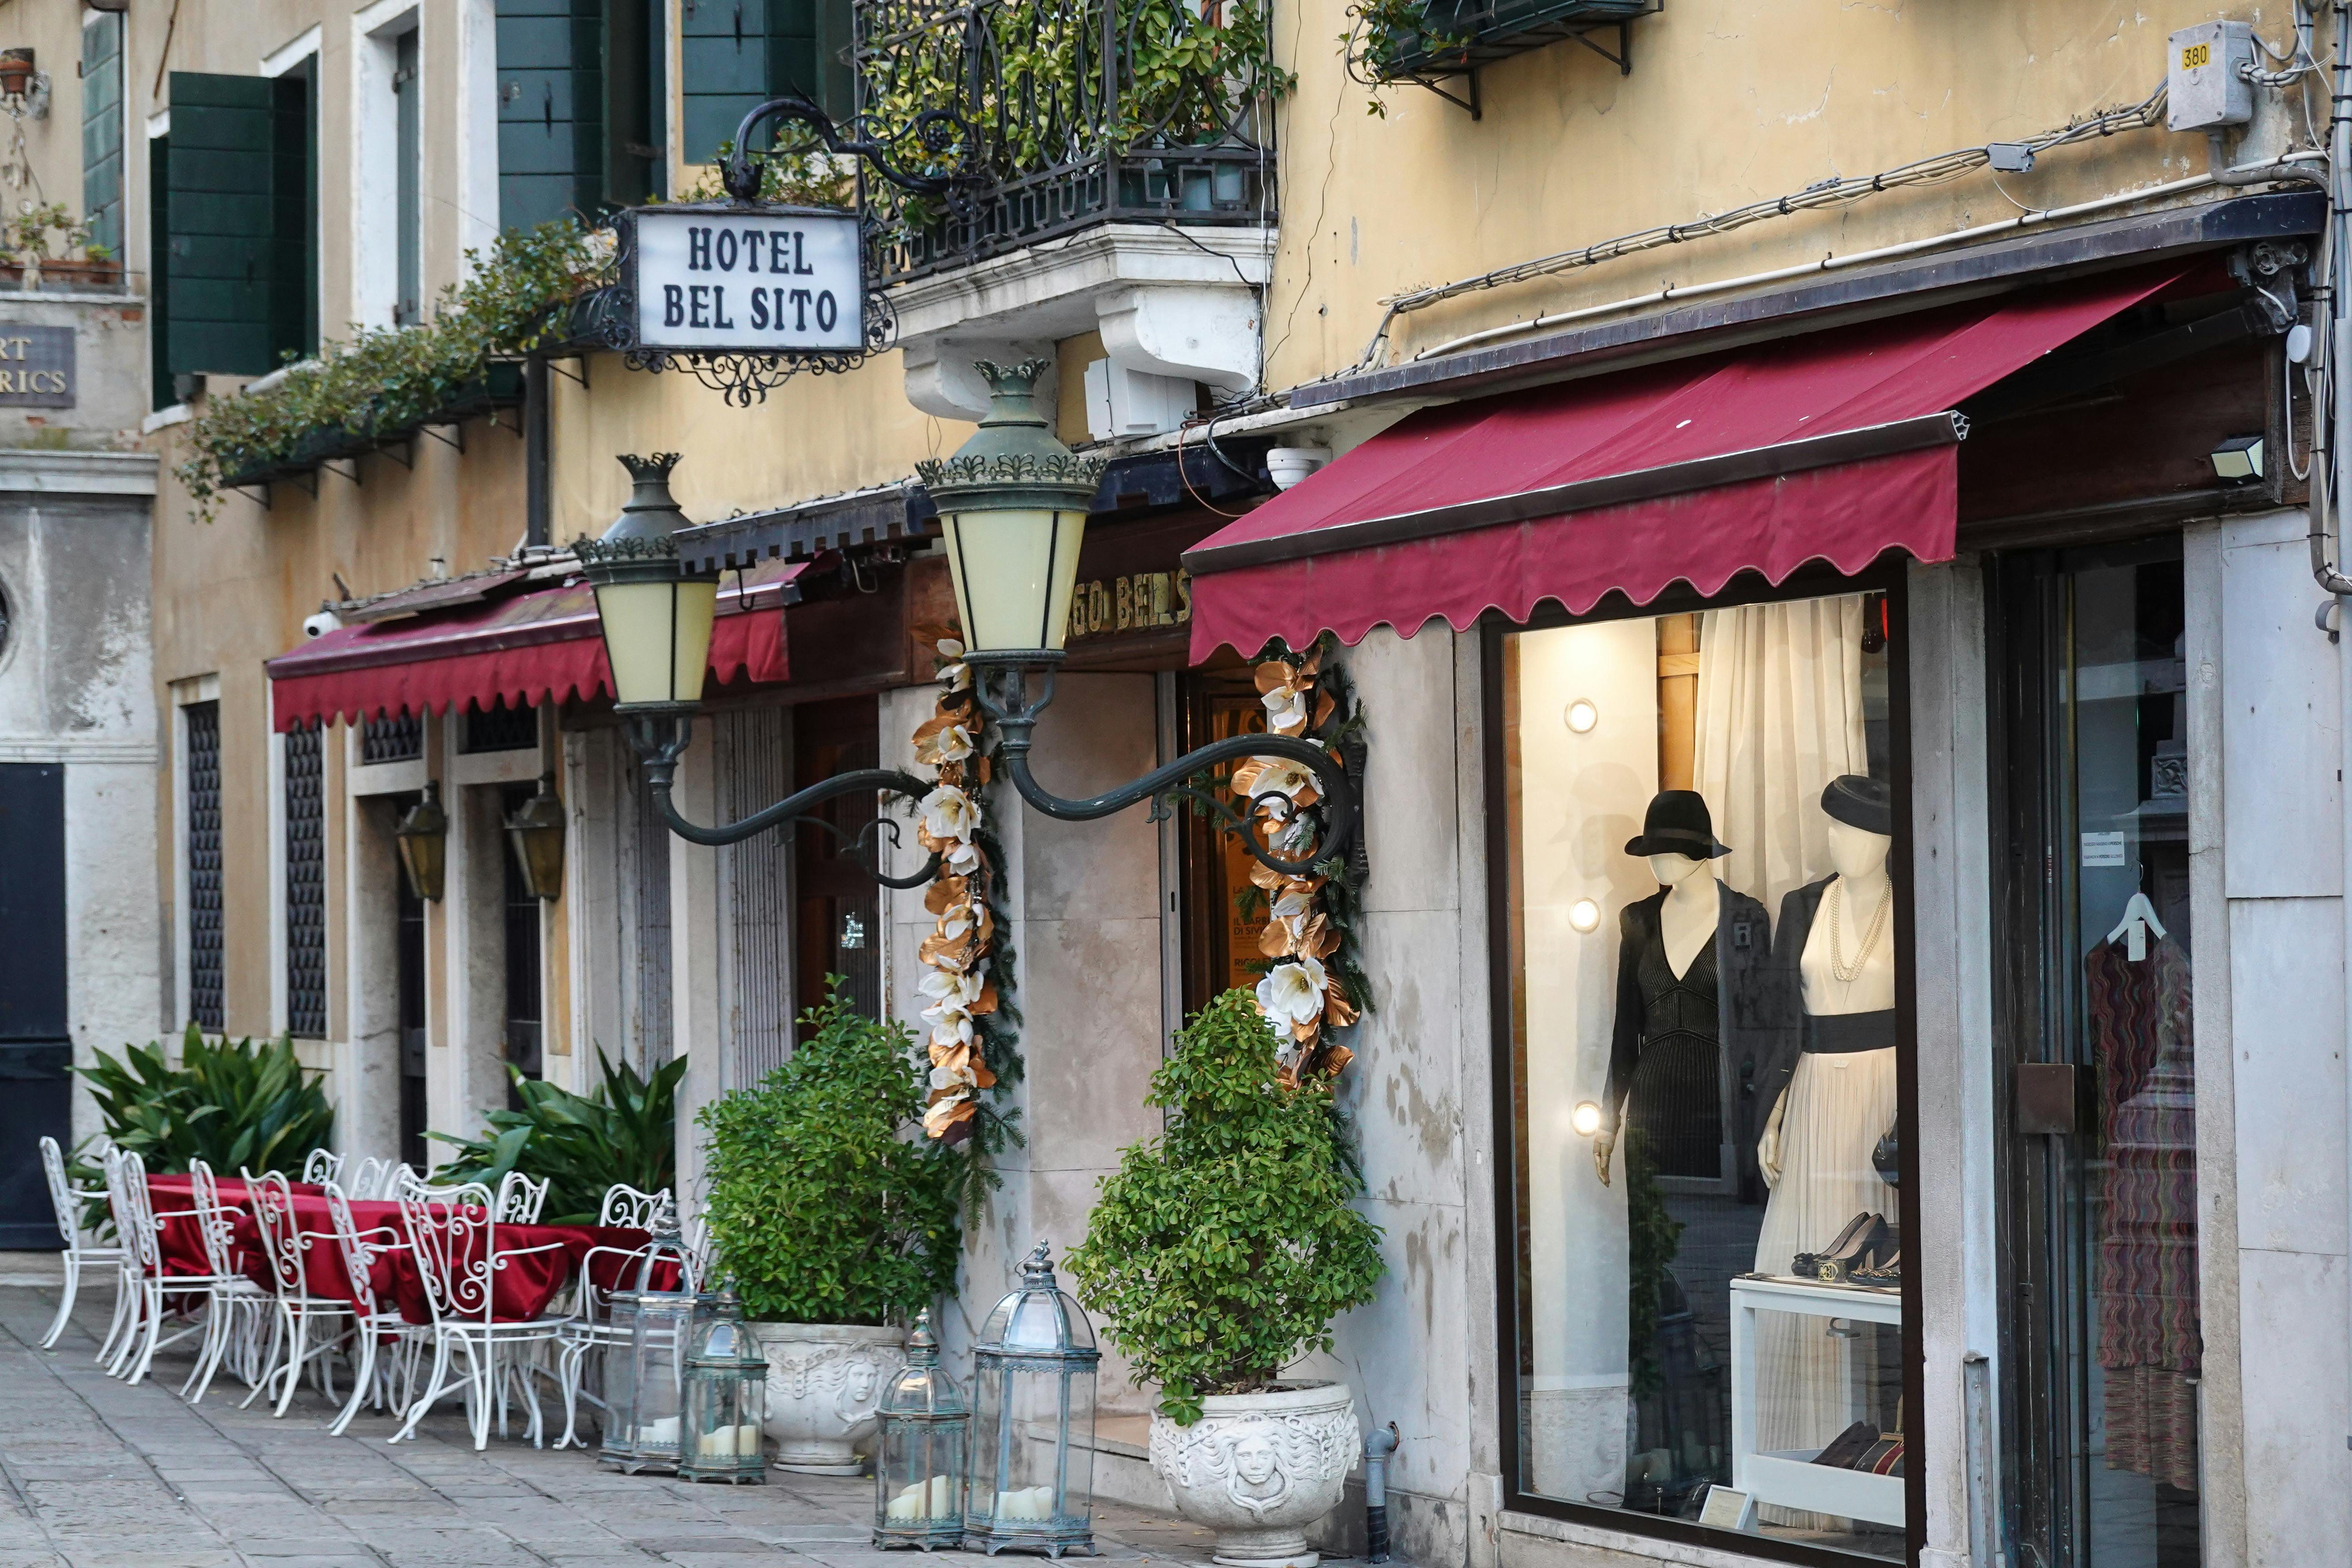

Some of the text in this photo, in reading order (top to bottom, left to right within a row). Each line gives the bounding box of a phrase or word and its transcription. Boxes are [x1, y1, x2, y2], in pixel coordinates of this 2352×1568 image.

[2184, 45, 2206, 67] 380
[688, 227, 814, 275] HOTEL
[664, 285, 837, 333] BEL SITO
[0, 370, 66, 394] RICS
[1067, 580, 1103, 636] GO
